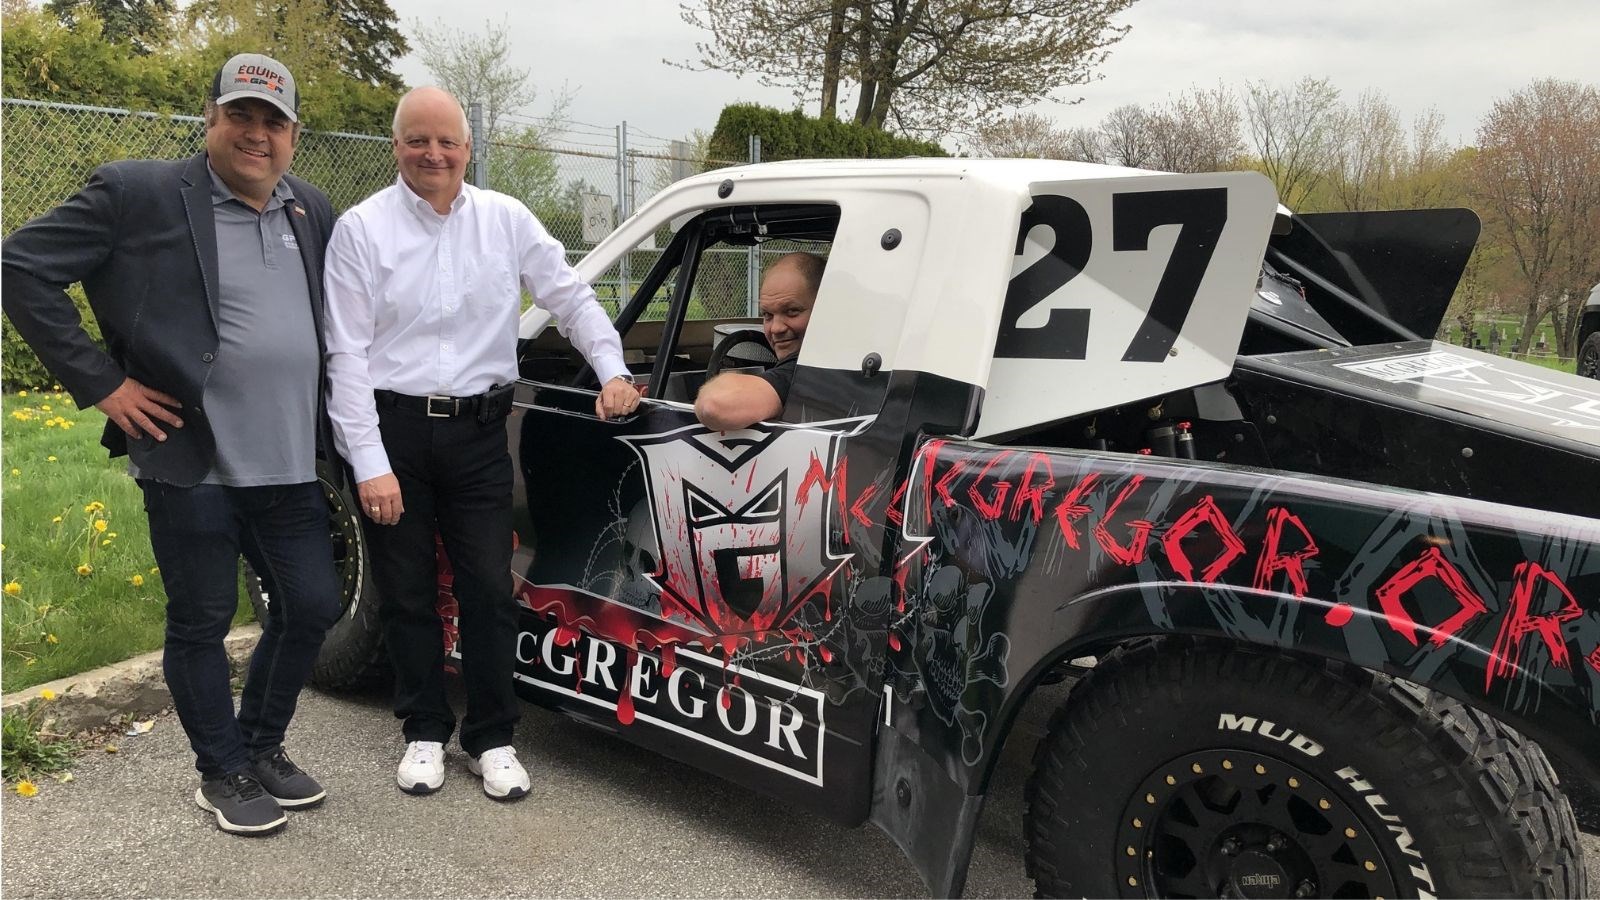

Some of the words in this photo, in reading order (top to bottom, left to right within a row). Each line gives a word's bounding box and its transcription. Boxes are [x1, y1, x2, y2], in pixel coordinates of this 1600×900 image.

[237, 64, 286, 86] ÉQUIPE
[993, 187, 1228, 362] 27
[1217, 713, 1325, 757] MUD
